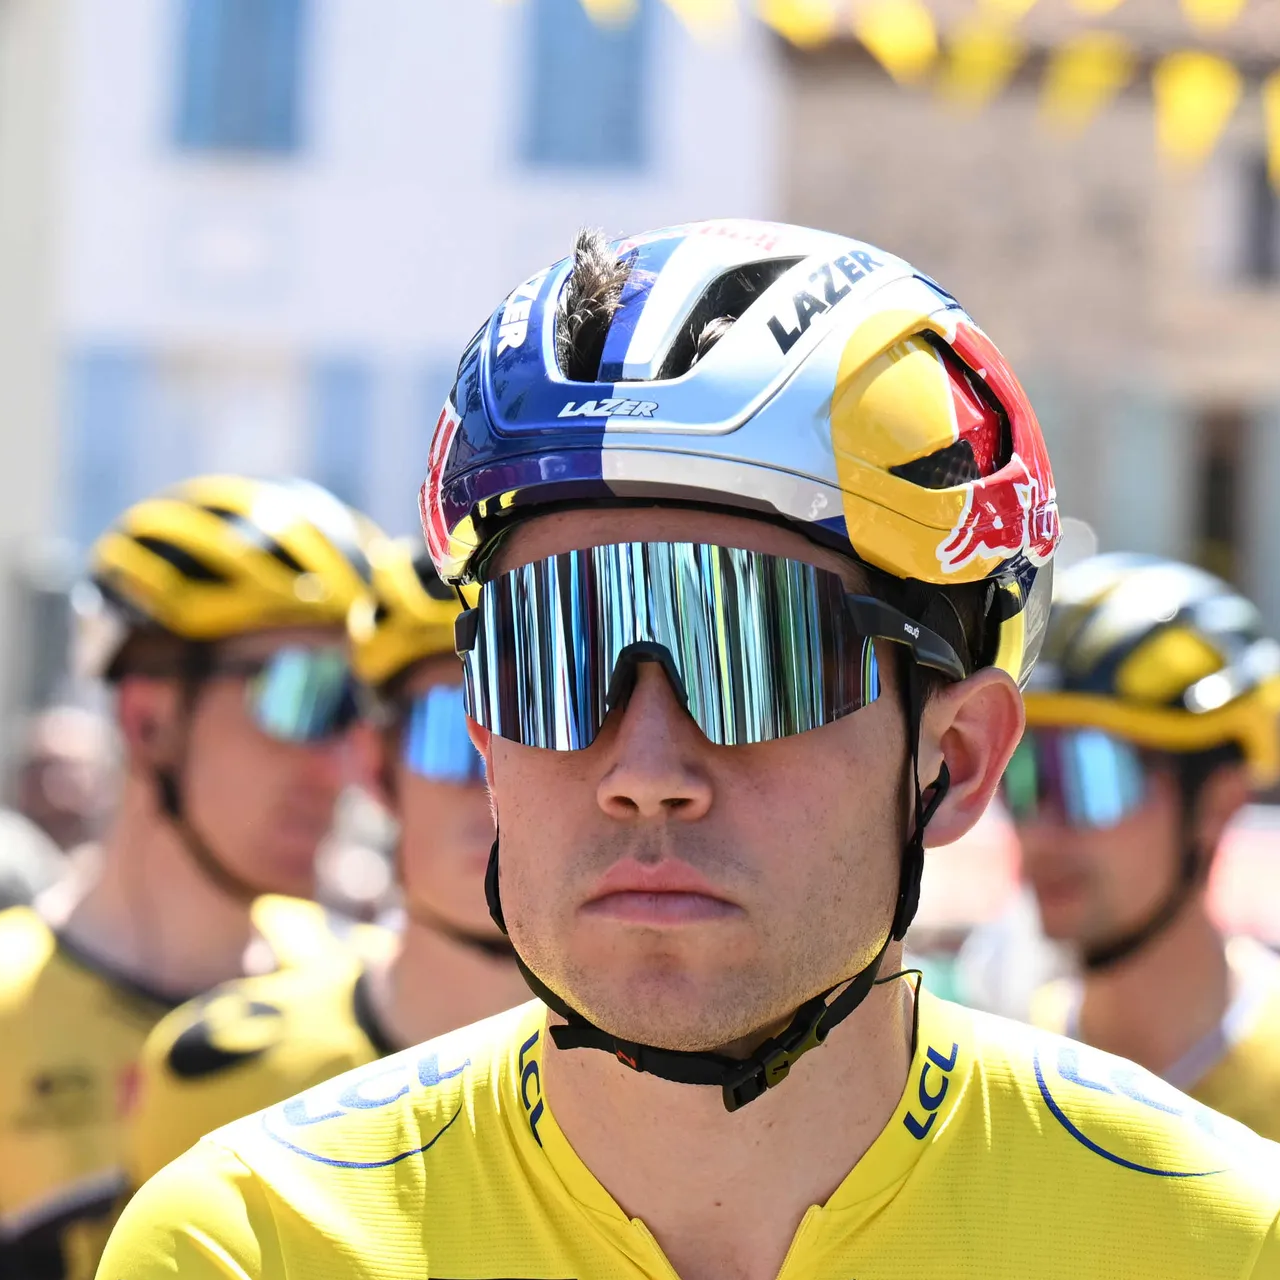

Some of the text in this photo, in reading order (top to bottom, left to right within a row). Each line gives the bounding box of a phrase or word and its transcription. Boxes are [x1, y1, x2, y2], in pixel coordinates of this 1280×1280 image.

[766, 249, 884, 355] LAZER
[557, 398, 658, 418] LAZER
[282, 1052, 471, 1127] LCL
[519, 1029, 545, 1149] LCL
[903, 1042, 959, 1141] LCL
